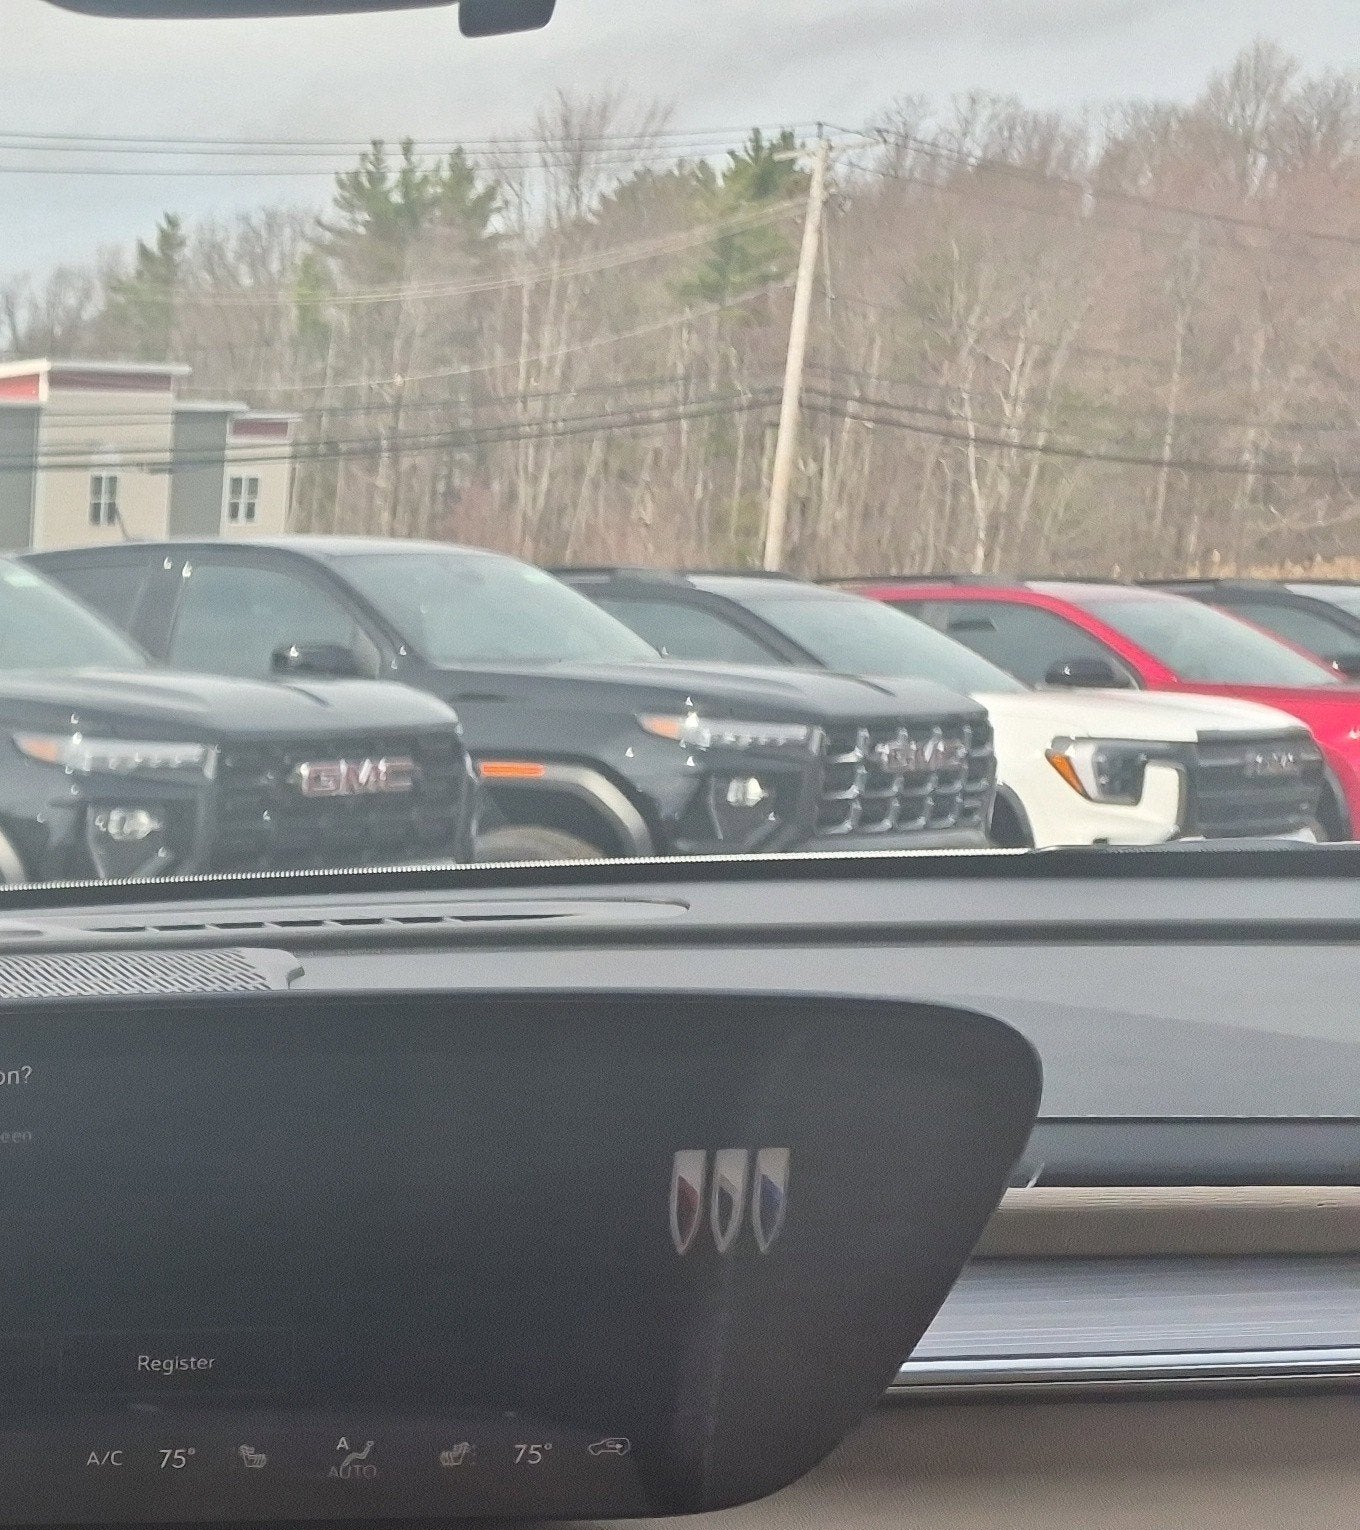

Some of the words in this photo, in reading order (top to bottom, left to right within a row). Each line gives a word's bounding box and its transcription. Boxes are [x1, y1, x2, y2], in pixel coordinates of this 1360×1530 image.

[299, 757, 414, 797] GMC
[137, 1354, 216, 1376] Register
[86, 1450, 123, 1468] A/C
[158, 1446, 196, 1469] 75°
[513, 1442, 553, 1465] 75°
